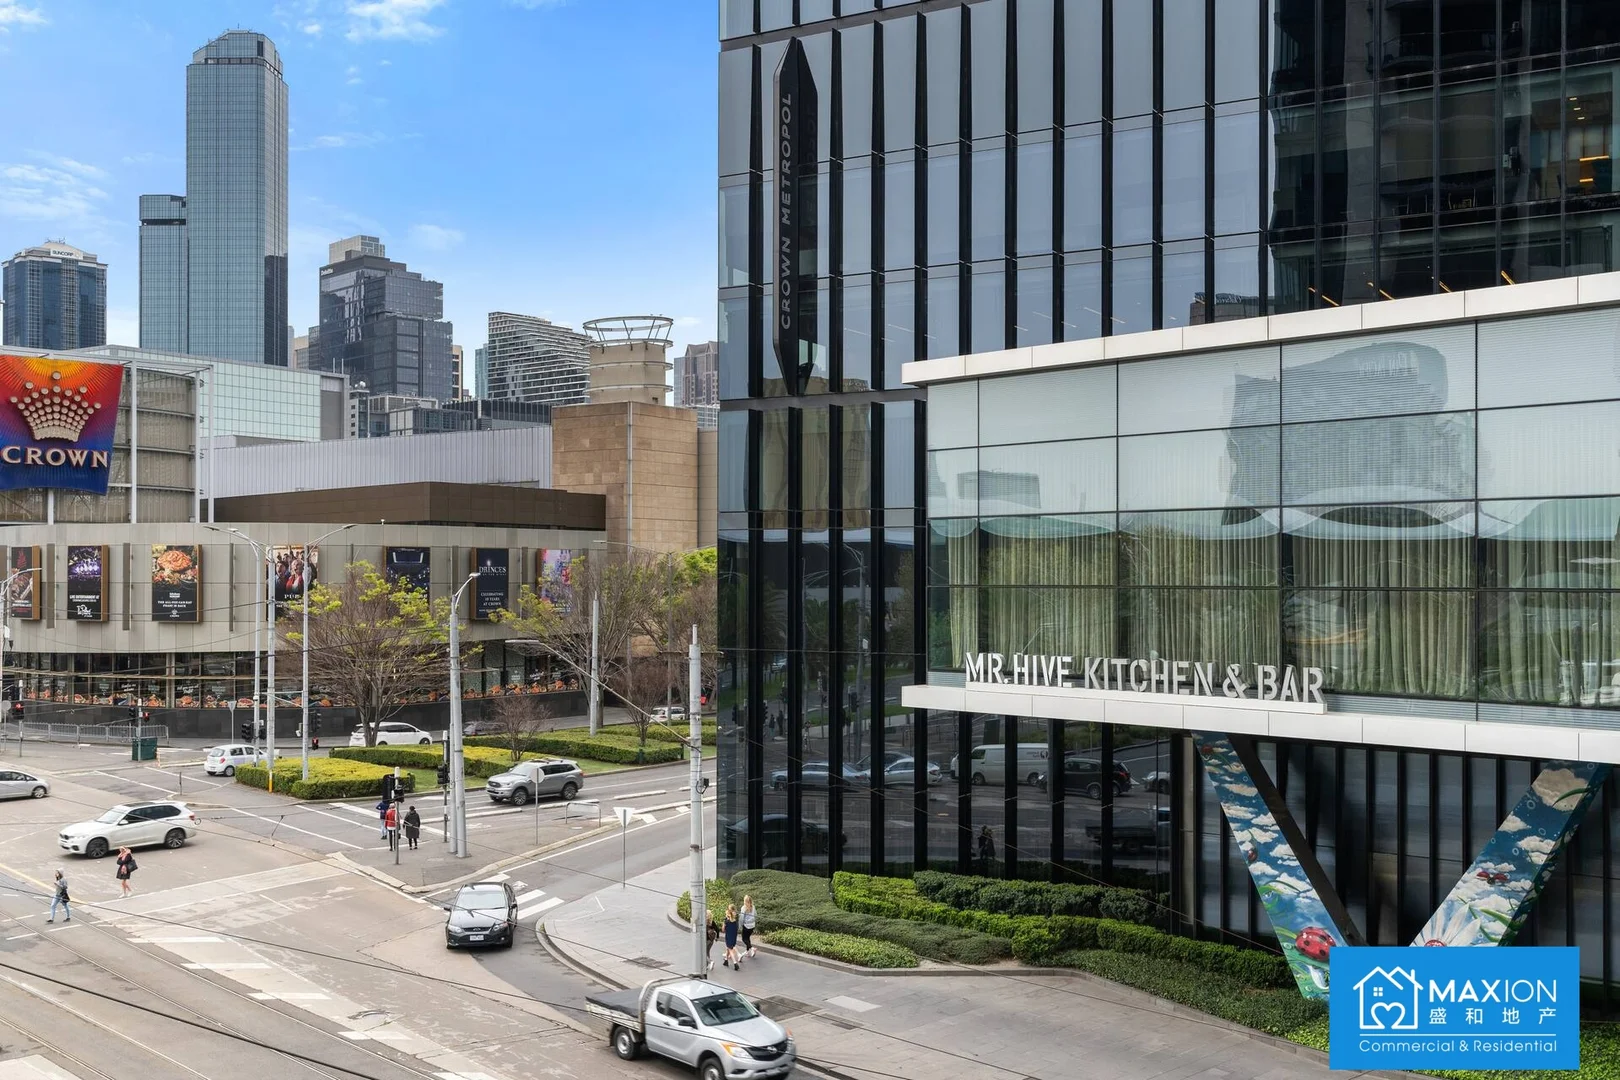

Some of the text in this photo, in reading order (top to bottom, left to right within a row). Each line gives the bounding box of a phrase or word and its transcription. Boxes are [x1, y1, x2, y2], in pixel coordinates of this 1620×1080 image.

[780, 93, 792, 330] CROWN METROPOL
[0, 446, 109, 468] CROWN
[1084, 657, 1216, 696] KITCHEN
[1222, 663, 1247, 698] &
[1257, 663, 1324, 702] BAR
